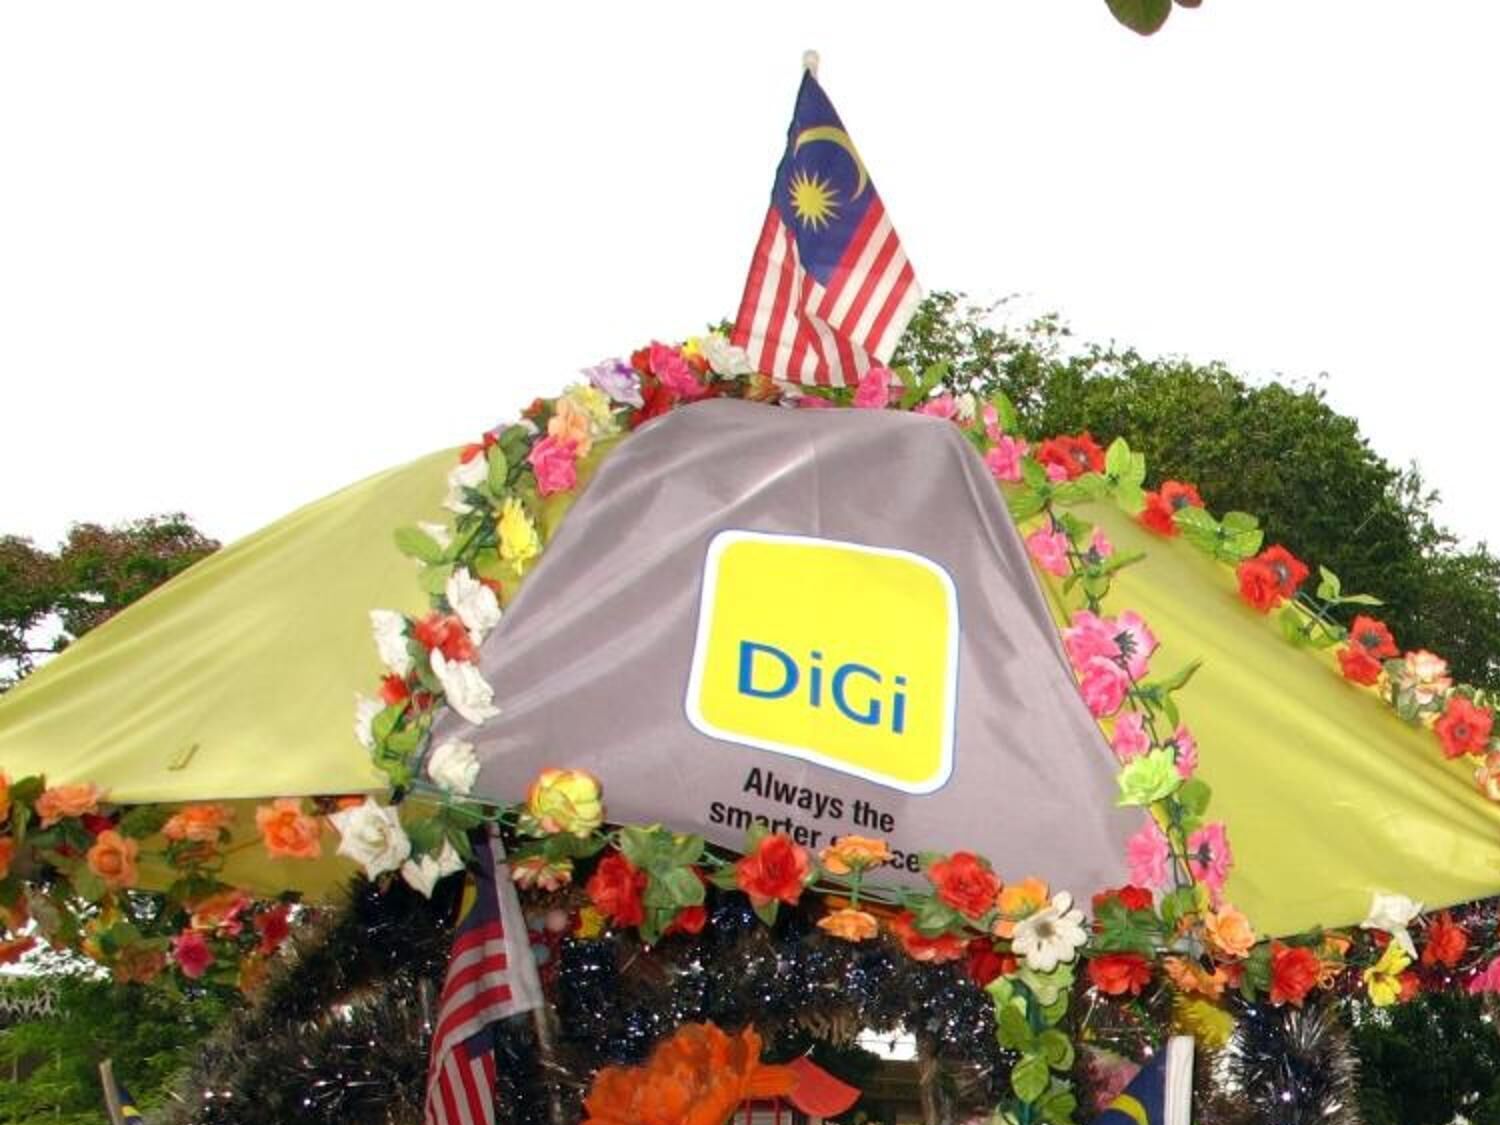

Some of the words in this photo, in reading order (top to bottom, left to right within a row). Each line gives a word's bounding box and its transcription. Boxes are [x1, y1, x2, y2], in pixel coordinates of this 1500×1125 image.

[737, 640, 910, 734] DiGi
[743, 767, 844, 819] Always
[853, 799, 896, 833] the
